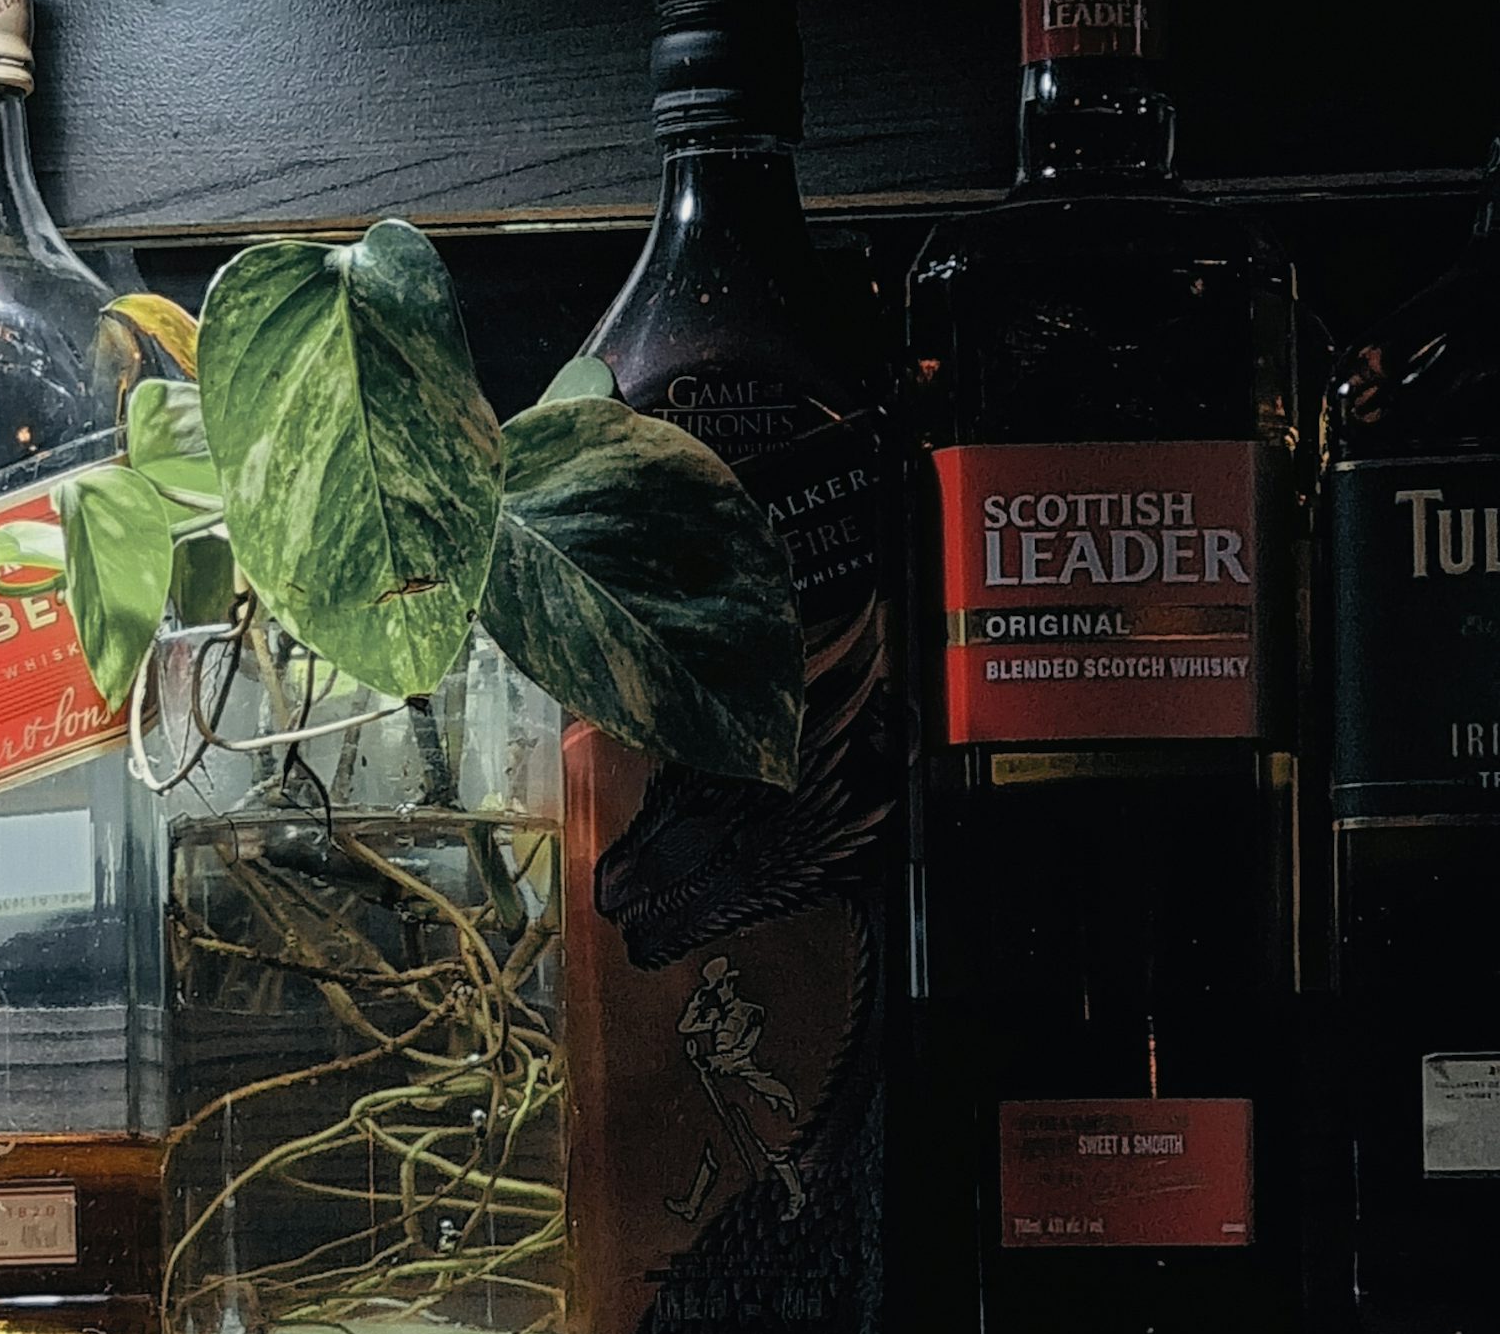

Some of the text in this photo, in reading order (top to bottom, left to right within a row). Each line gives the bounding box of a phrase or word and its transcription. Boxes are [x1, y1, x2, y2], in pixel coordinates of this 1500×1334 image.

[1043, 2, 1150, 32] LEADER
[654, 408, 797, 438] THRONES
[764, 467, 869, 527] ALKER
[983, 492, 1196, 530] SCOTTISH
[781, 517, 861, 557] FIRE
[791, 552, 875, 592] WHISKY
[983, 528, 1252, 587] LEADER
[985, 612, 1131, 639] ORIGINAL
[3, 643, 83, 680] WHISK
[985, 656, 1252, 681] BLENDED SCOTCH WHISKY
[41, 686, 114, 749] Sons
[1077, 1133, 1185, 1155] SWEET SMOOTH
[7, 1204, 57, 1219] 1820
